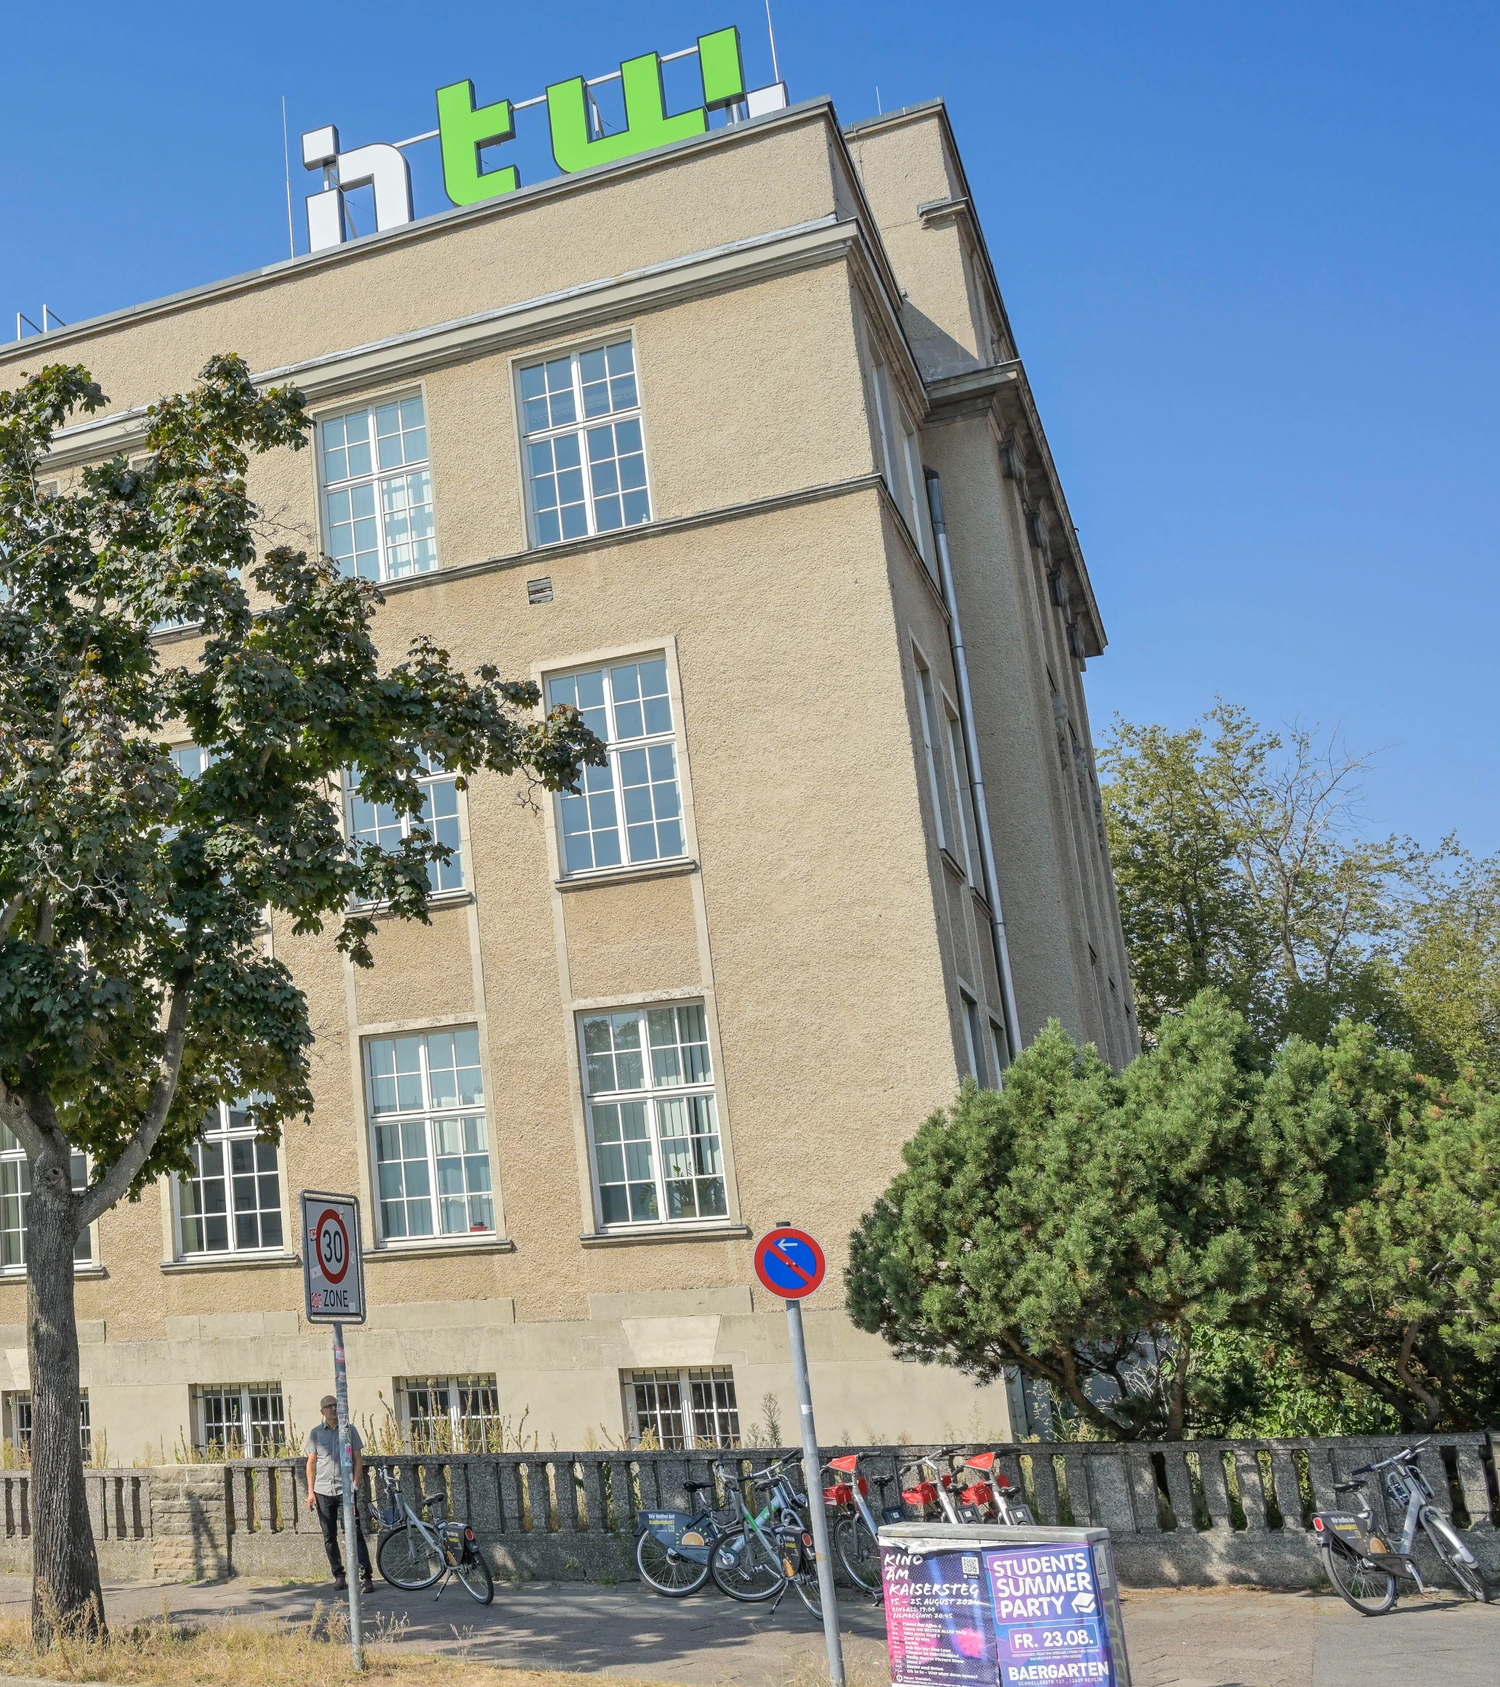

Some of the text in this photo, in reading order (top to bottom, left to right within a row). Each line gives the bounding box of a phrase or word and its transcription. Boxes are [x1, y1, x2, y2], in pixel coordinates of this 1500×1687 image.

[323, 1230, 342, 1263] 30
[322, 1290, 349, 1308] ZONE
[884, 1553, 923, 1566] KINO
[993, 1553, 1088, 1577] STUDENTS
[886, 1568, 909, 1580] AM
[889, 1583, 979, 1598] KAISERSTEG
[996, 1572, 1092, 1598] SUMMER
[923, 1598, 955, 1606] AUGUST
[1000, 1596, 1064, 1618] PARTY
[1014, 1629, 1094, 1649] FR. 23.08.
[1008, 1661, 1109, 1681] BAERGARTEN
